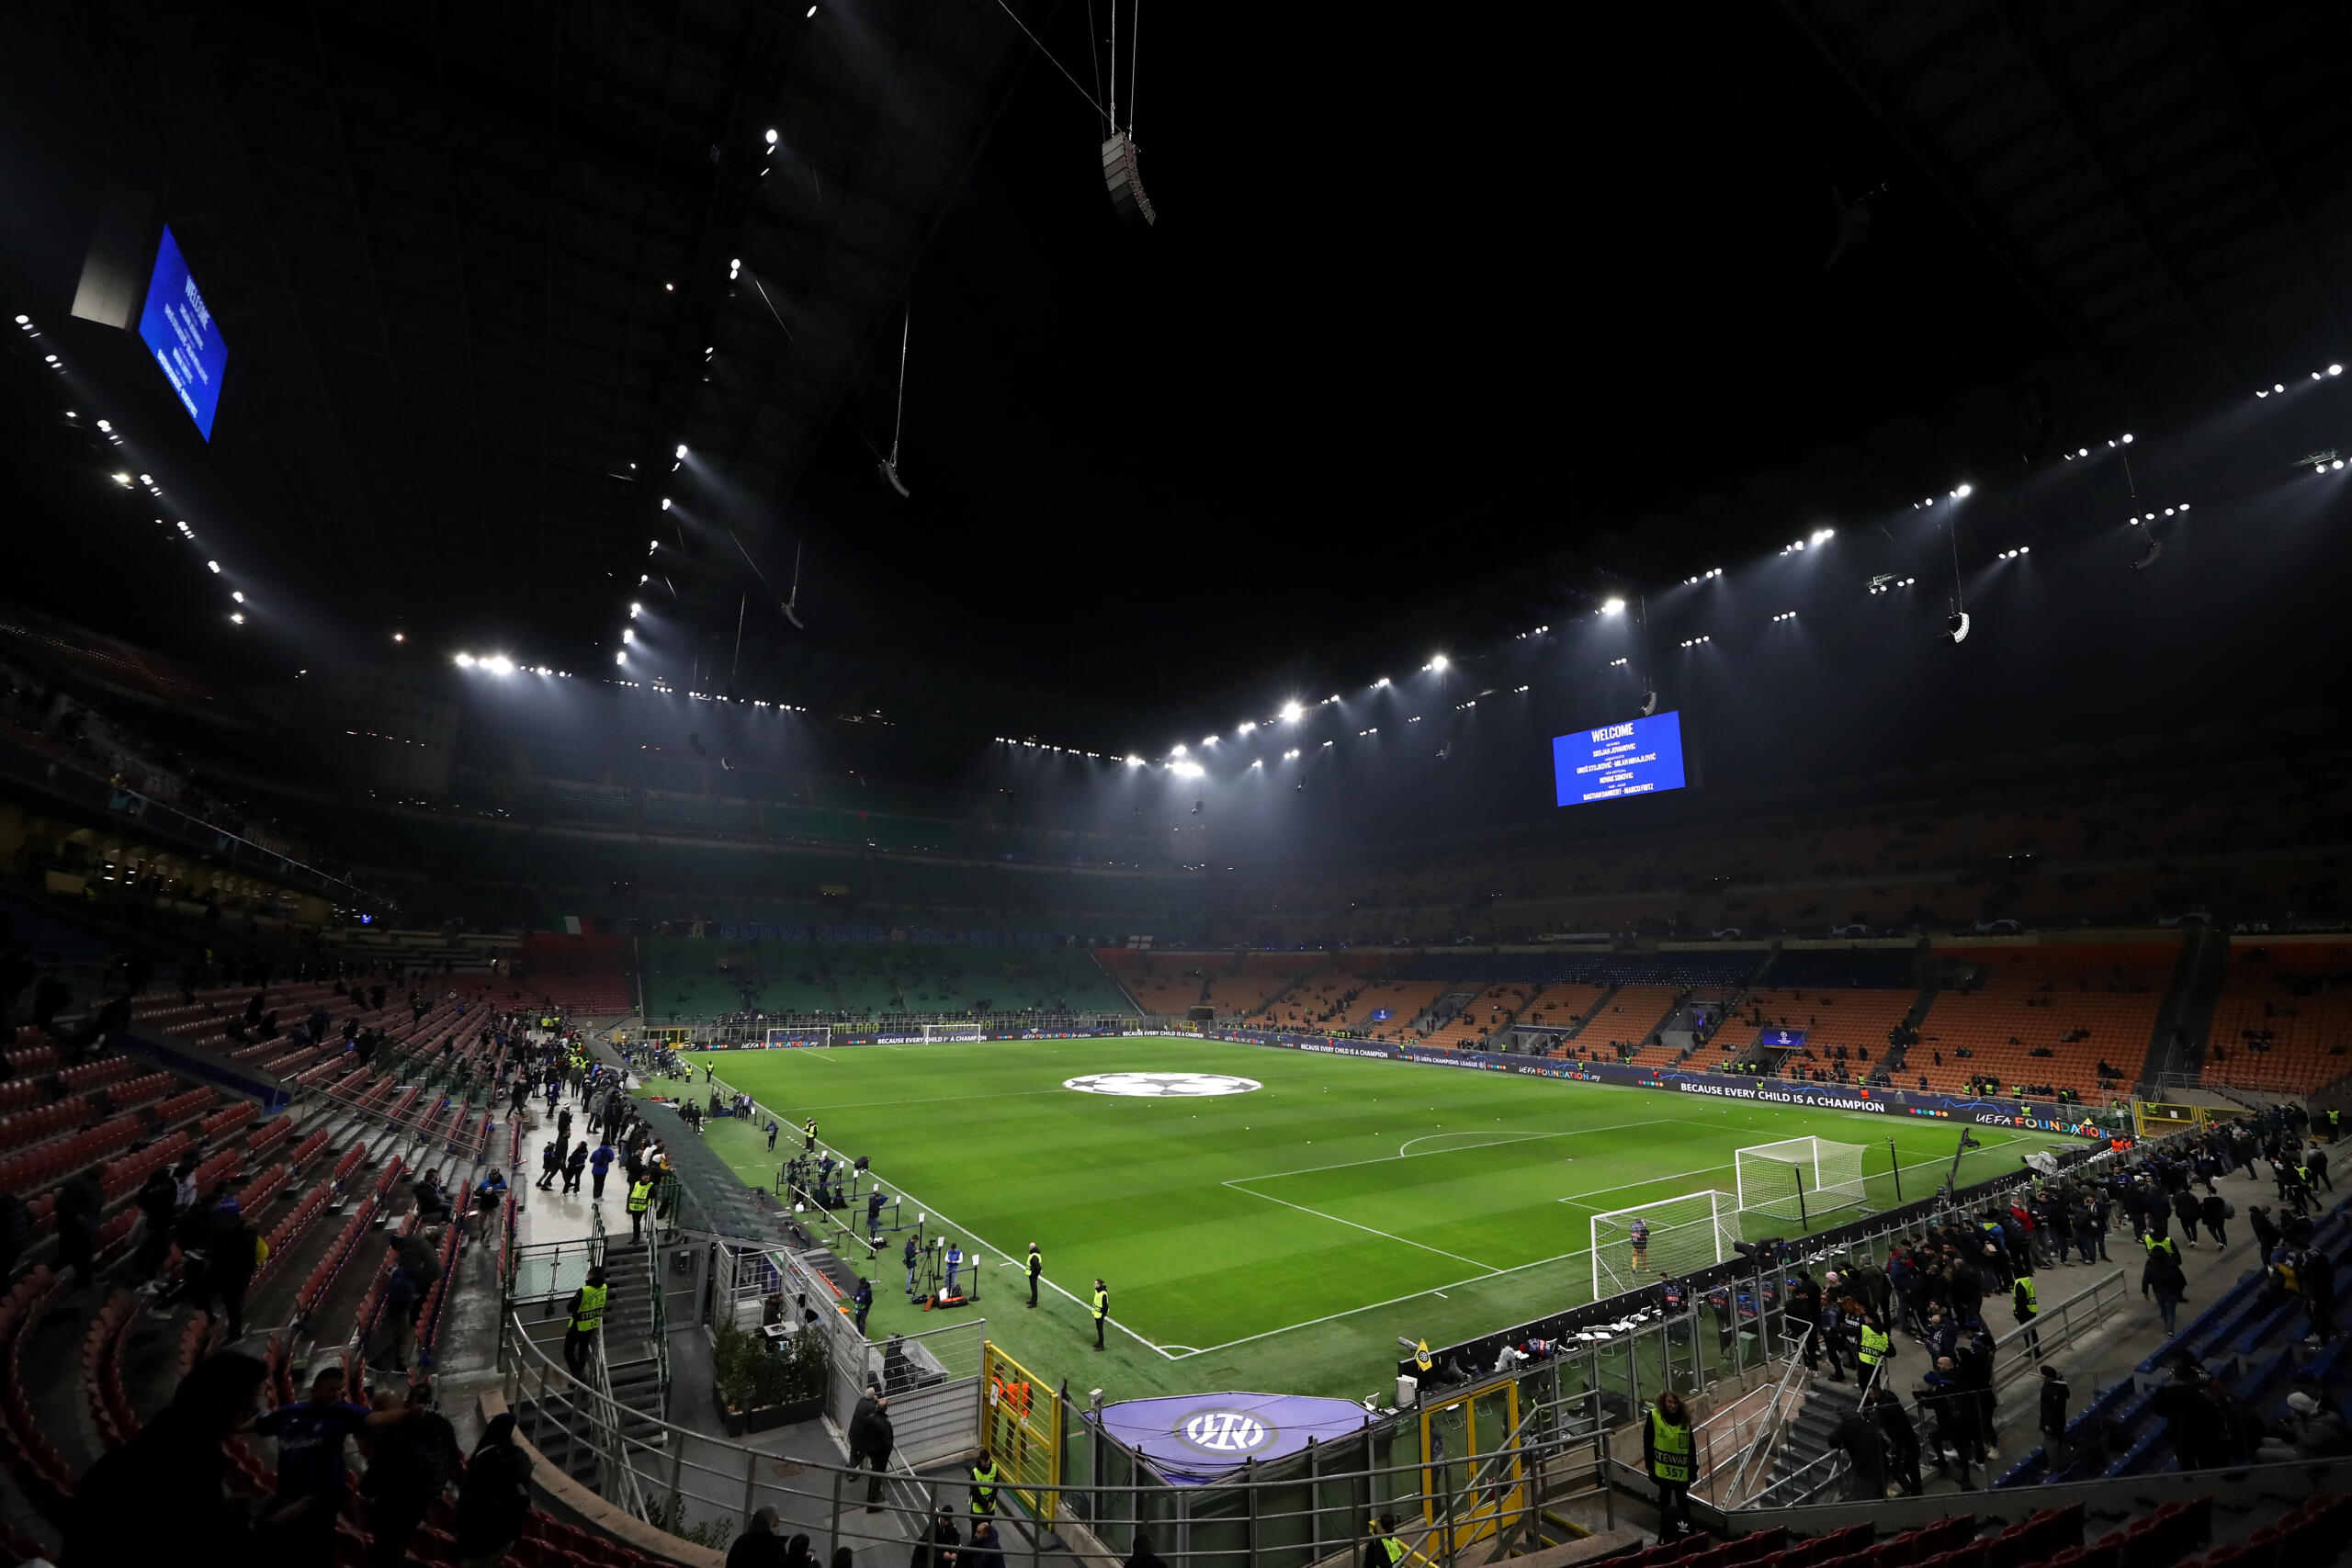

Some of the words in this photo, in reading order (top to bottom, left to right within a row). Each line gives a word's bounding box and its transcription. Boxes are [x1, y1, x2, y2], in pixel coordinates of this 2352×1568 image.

[185, 275, 210, 331] WELCOME
[1591, 722, 1634, 743] WELCOME
[1300, 1043, 1319, 1052] BECAUSE
[1360, 1049, 1388, 1058] CHAMPION
[1432, 1057, 1459, 1066] CHAMPIONS
[1518, 1066, 1536, 1075] UEFA
[1536, 1067, 1589, 1081] FOUNDATION
[1680, 1082, 1723, 1096] BECAUSE
[1724, 1087, 1756, 1099] EVERY
[1758, 1090, 1791, 1102] CHILD
[1793, 1094, 1804, 1104] IS
[1806, 1095, 1815, 1105] A
[1817, 1097, 1885, 1113] CHAMPION
[1975, 1112, 2012, 1126] UEFA
[2015, 1116, 2107, 1139] FOUNDATION
[1655, 1451, 1689, 1466] STEWAR
[1665, 1465, 1684, 1478] 357
